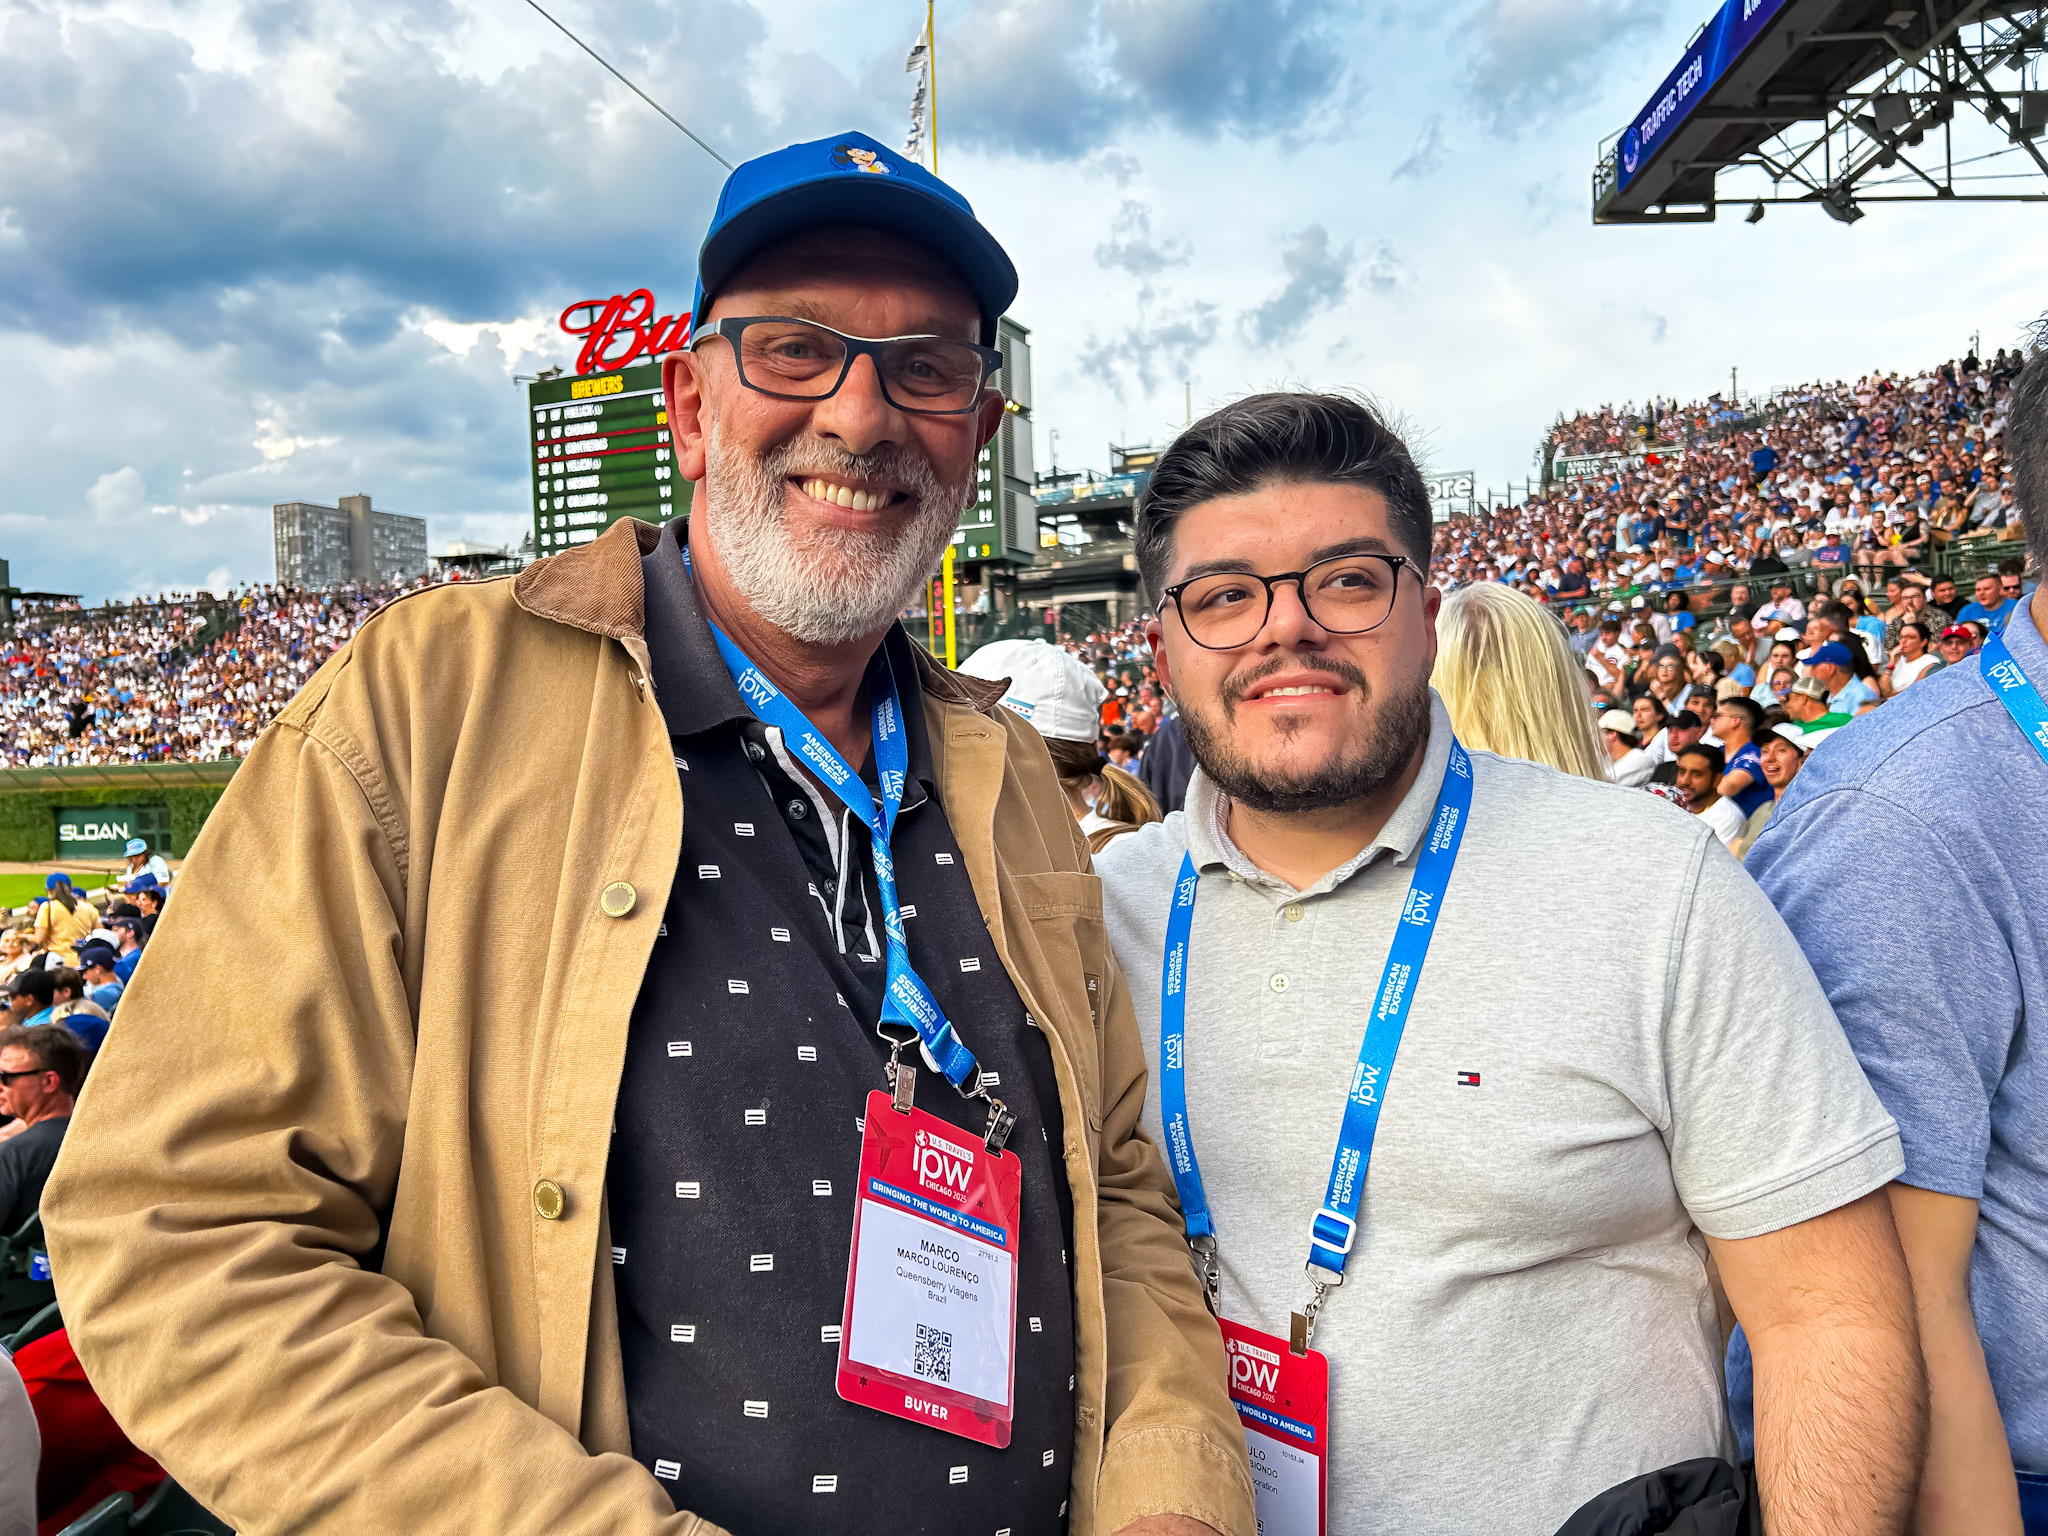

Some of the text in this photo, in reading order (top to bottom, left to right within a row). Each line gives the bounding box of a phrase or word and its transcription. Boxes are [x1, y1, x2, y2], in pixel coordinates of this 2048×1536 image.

[1641, 55, 1702, 144] TRAFFIC TECH
[878, 702, 888, 741] AMERICAN
[885, 697, 896, 733] EXPRESS
[801, 732, 850, 780] AMERICAN
[801, 743, 845, 785] EXPRESS
[60, 822, 128, 841] SLOAN
[1430, 804, 1450, 854] AMERICAN
[1440, 807, 1460, 850] EXPRESS
[1167, 950, 1176, 996] EXPRESS
[1173, 942, 1184, 994] AMERICAN
[1389, 964, 1411, 1015] EXPRESS
[890, 981, 936, 1034] AMERICAN
[897, 973, 938, 1022] EXPRESS
[1377, 962, 1402, 1022] AMERICAN
[931, 1138, 972, 1161] U.S. TRAVEL'S
[1169, 1121, 1184, 1175] EXPRESS
[1174, 1112, 1192, 1172] AMERICAN
[925, 1179, 967, 1203] CHICAGO 2025
[1330, 1147, 1351, 1210] AMERICAN
[1340, 1149, 1360, 1204] EXPRESS
[872, 1181, 1004, 1242] BRINGING THE WORLD TO AMERICA
[897, 1247, 979, 1284] MARCO LOURENÇO
[920, 1239, 960, 1263] MARCO
[896, 1266, 978, 1302] Queensberry Viagens
[927, 1290, 947, 1304] Brazil
[1240, 1343, 1278, 1363] U.S. TRAVEL'S
[904, 1395, 948, 1421] BUYER
[1237, 1382, 1276, 1403] CHICAGO 2025
[1242, 1404, 1267, 1420] WORLD
[1268, 1415, 1279, 1425] TO
[1280, 1420, 1312, 1438] AMERICA
